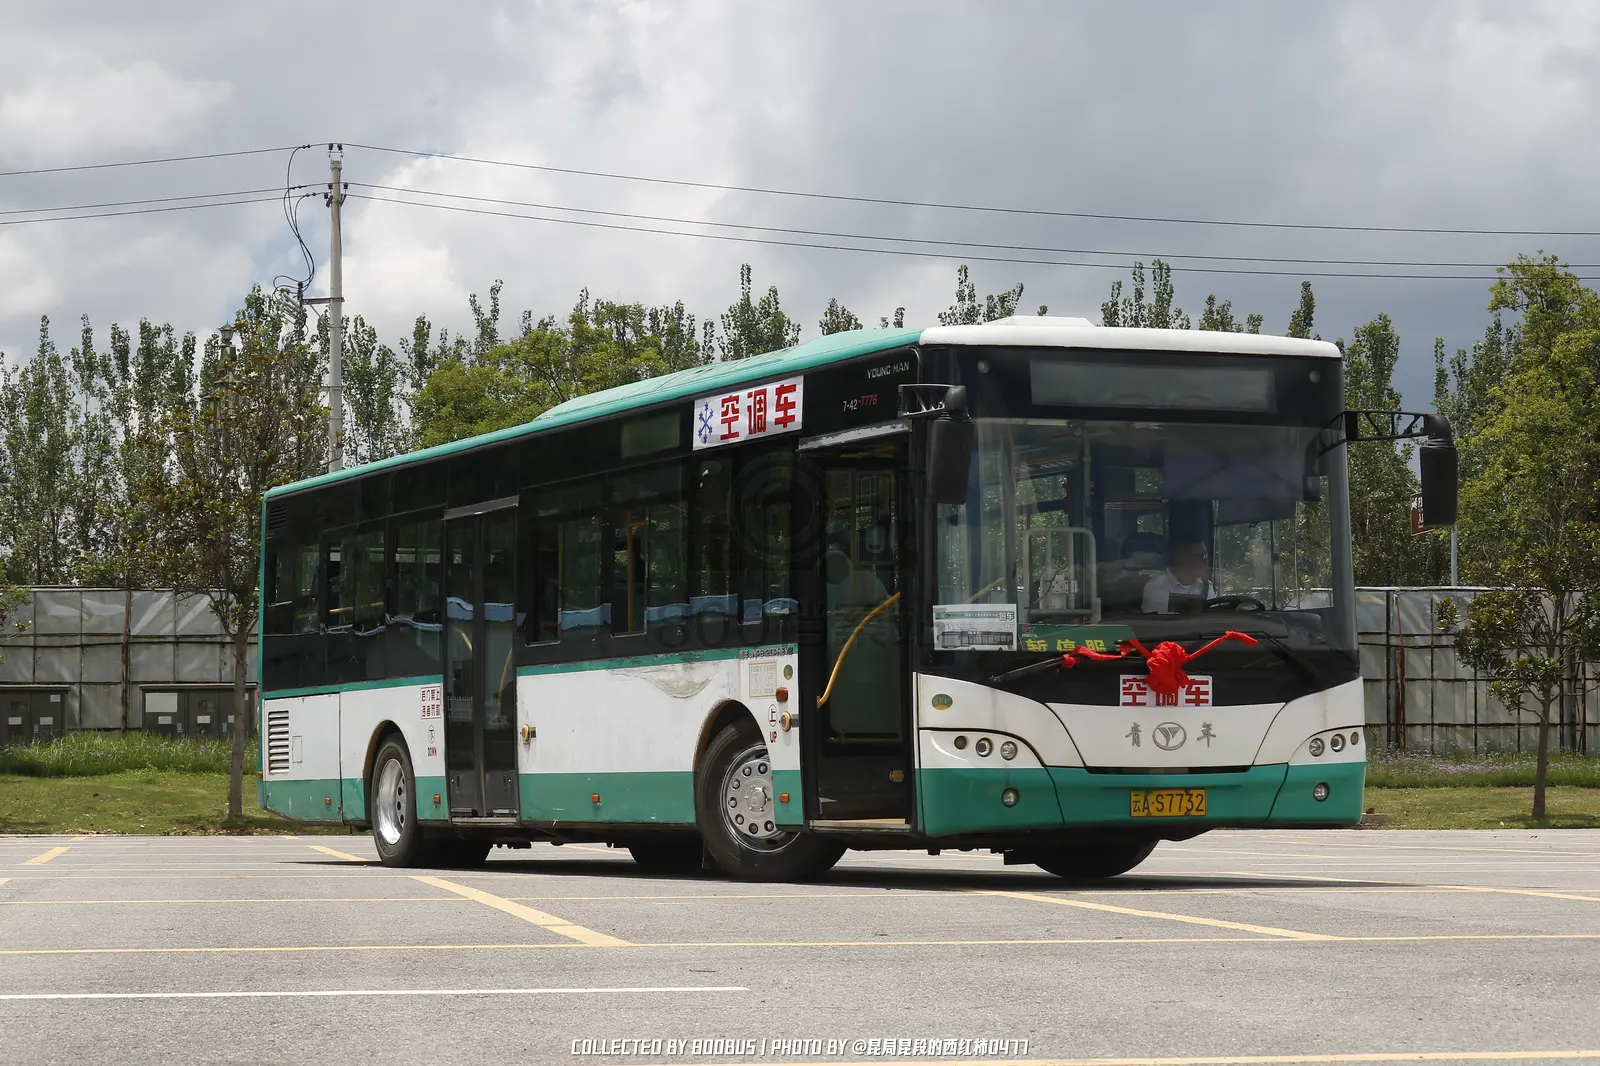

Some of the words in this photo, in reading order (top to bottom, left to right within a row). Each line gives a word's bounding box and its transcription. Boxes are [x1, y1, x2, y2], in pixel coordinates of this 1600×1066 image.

[867, 365, 891, 379] YOUNG
[892, 361, 909, 373] MAN
[720, 383, 797, 441] 空调车
[770, 731, 777, 743] UP
